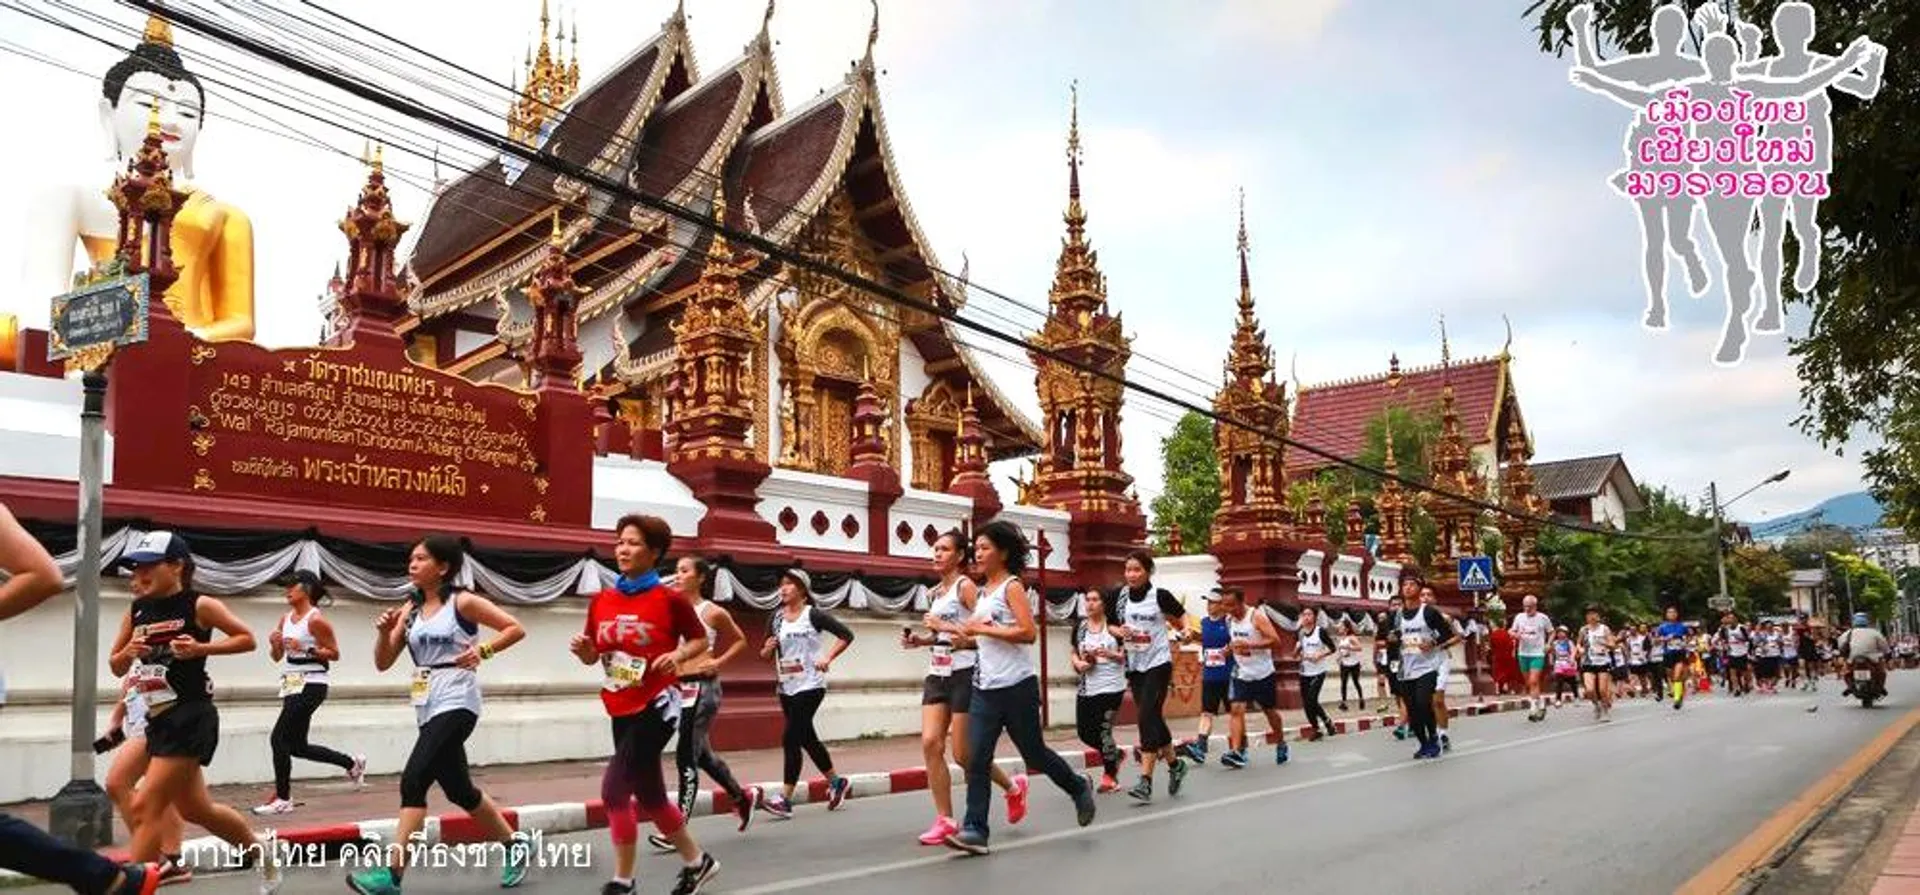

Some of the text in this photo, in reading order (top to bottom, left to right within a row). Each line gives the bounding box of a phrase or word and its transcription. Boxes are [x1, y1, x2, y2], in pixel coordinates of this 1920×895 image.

[222, 372, 251, 389] 149
[303, 452, 467, 497] พระเจ้าหลวงทันใจ
